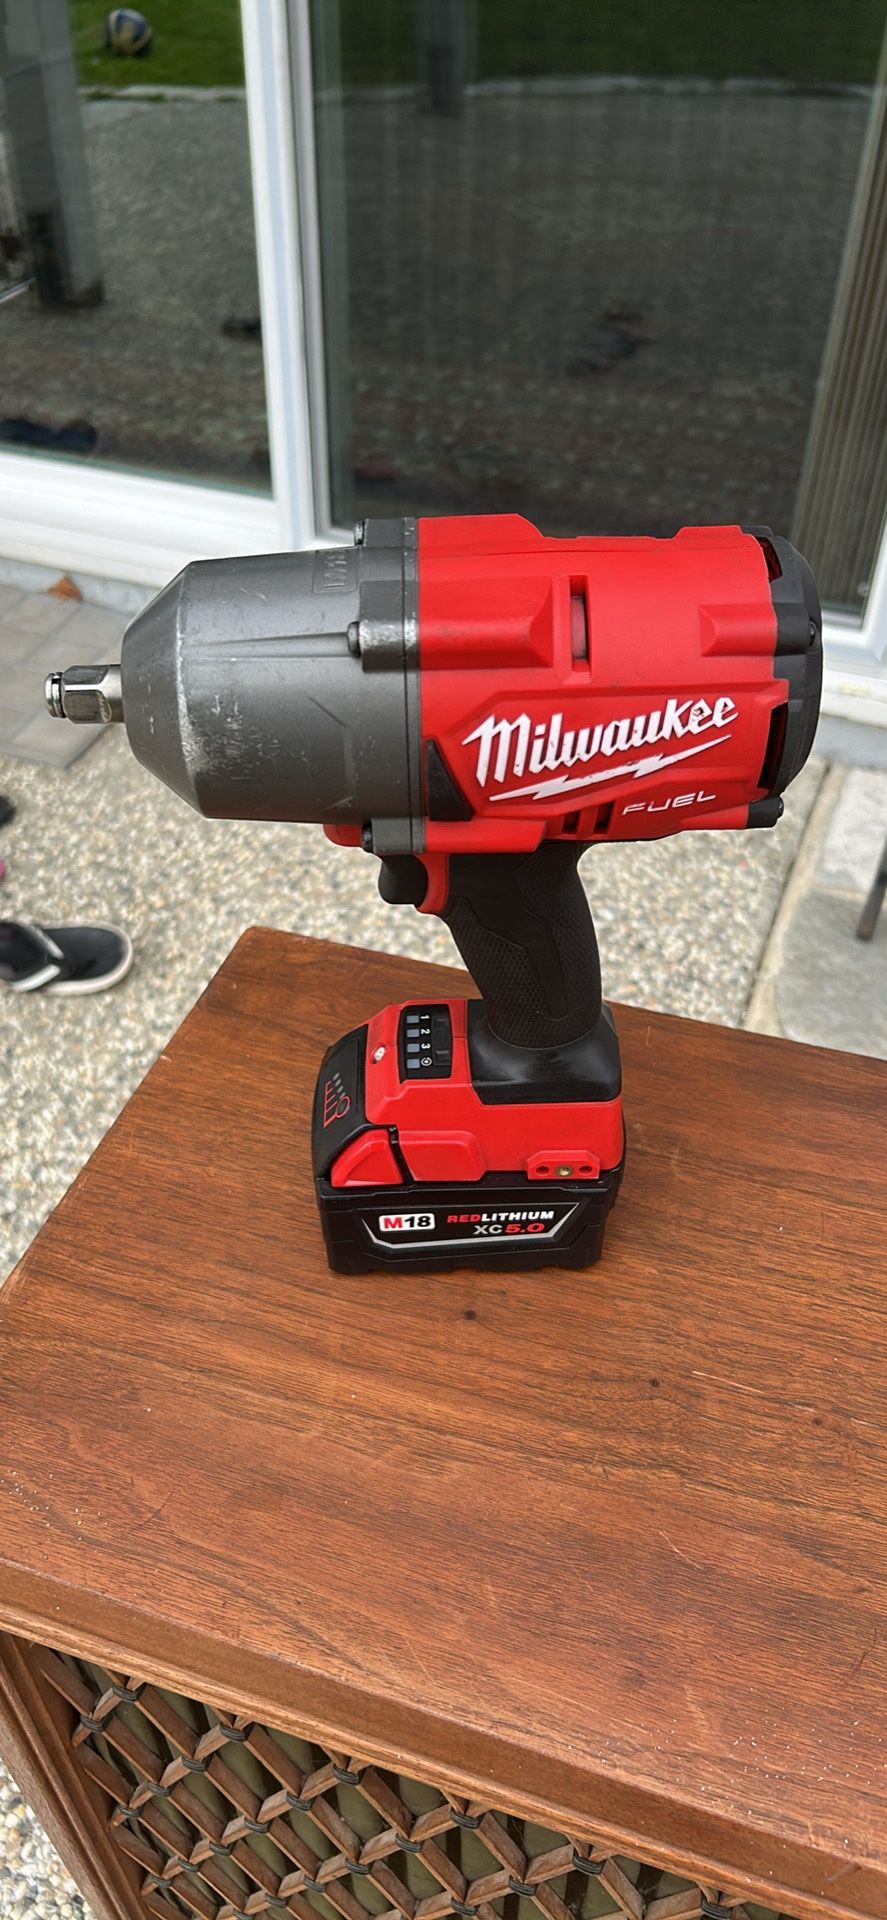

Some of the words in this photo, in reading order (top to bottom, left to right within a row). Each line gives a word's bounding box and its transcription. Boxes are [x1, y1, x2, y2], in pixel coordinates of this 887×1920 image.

[462, 696, 739, 788] Milwaukee
[622, 791, 716, 815] FUEL
[383, 1215, 431, 1229] M18
